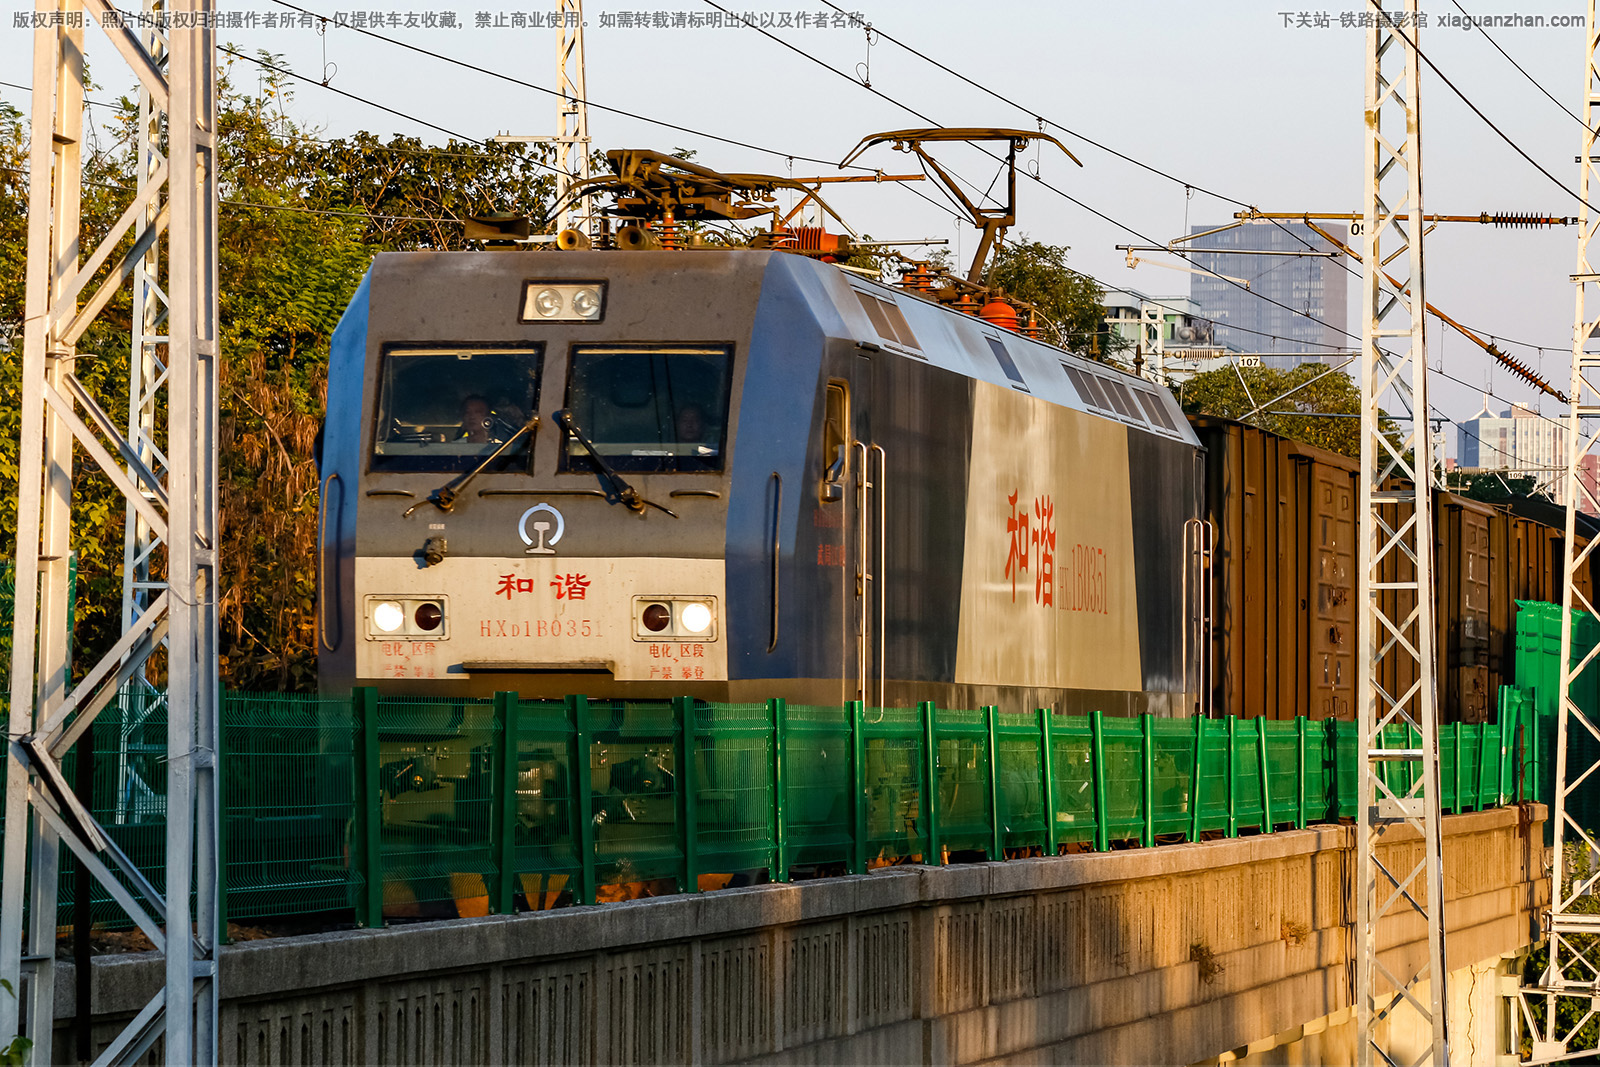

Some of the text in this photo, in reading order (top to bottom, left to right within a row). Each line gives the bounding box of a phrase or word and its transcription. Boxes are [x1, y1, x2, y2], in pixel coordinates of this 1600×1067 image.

[1351, 223, 1364, 236] 0
[1241, 358, 1259, 367] 107
[1005, 488, 1056, 608] 和谐
[480, 619, 604, 637] HXD1B0351
